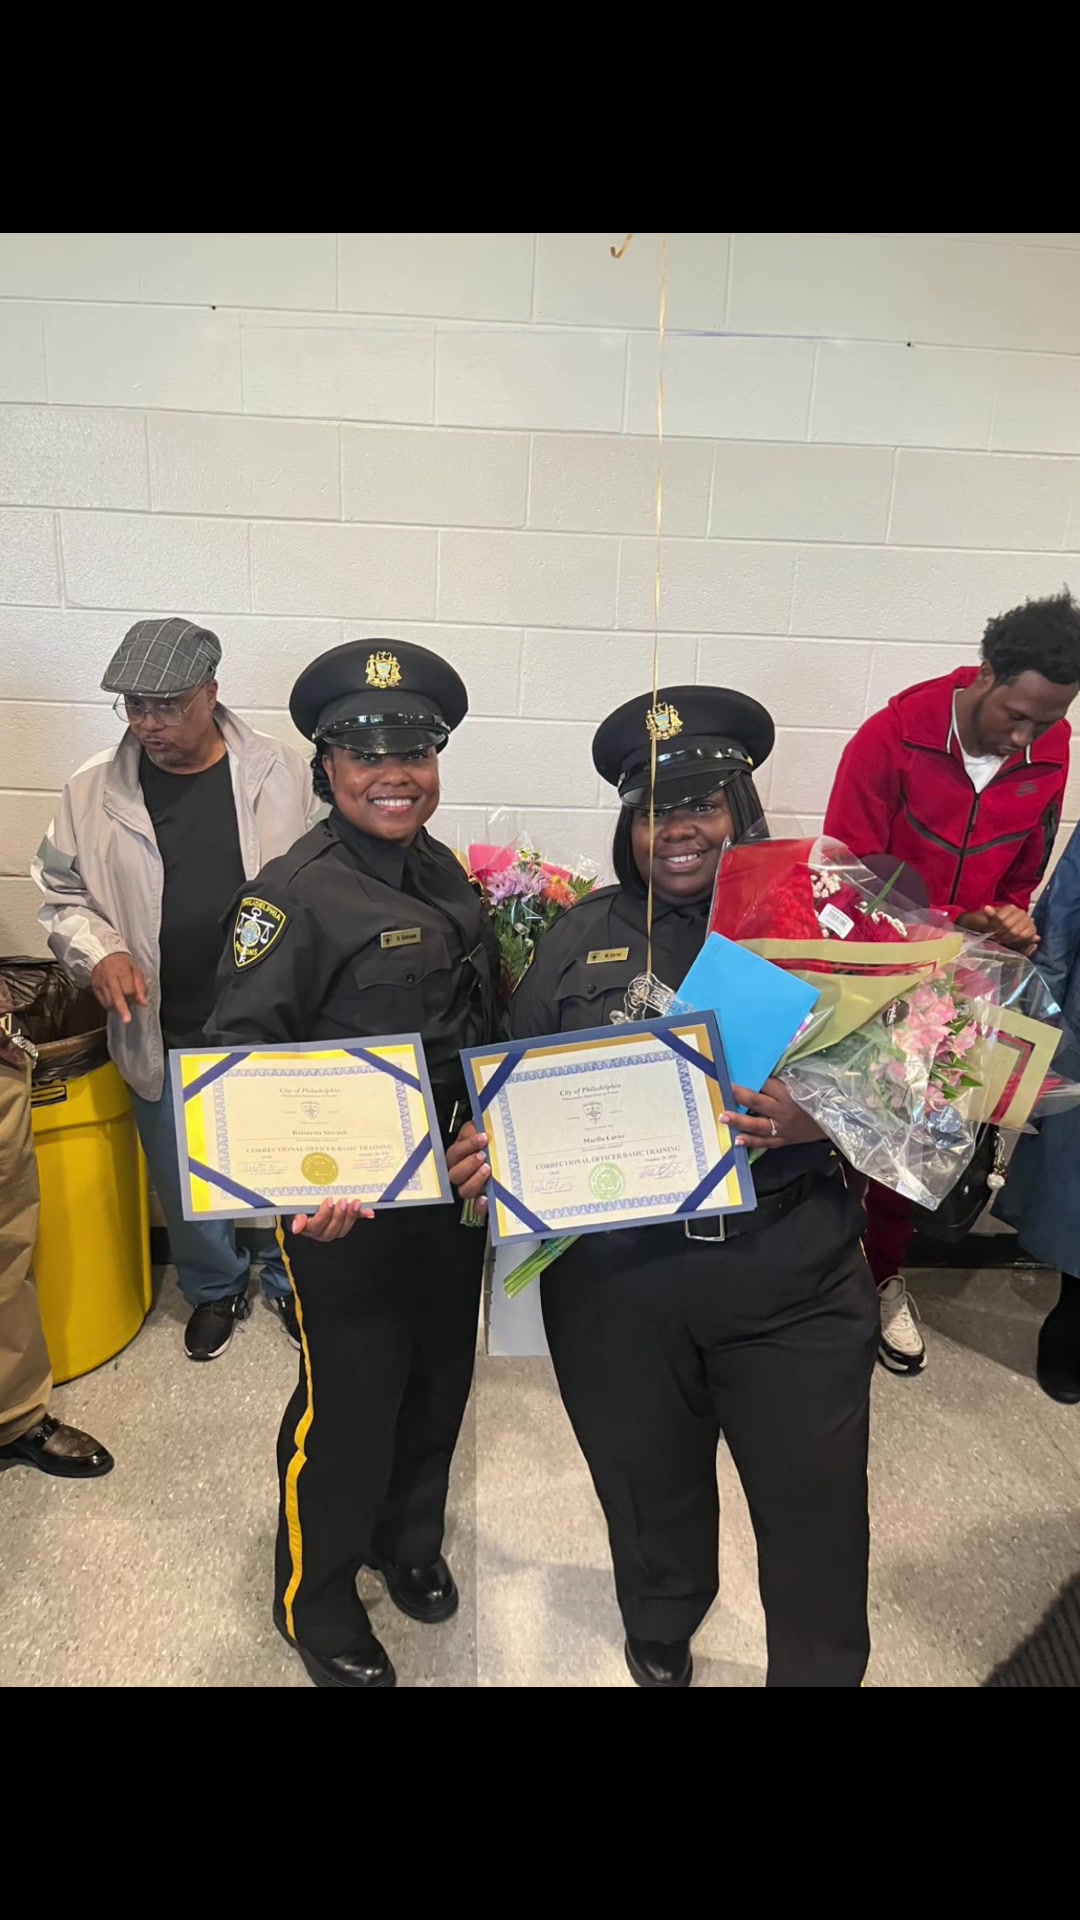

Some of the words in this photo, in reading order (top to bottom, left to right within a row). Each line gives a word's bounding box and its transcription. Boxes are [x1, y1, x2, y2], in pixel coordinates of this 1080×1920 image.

[241, 899, 281, 921] PHILADELPHIA
[582, 1083, 622, 1093] Philadelphia
[535, 1157, 590, 1170] CORRECTIONAL
[592, 1153, 623, 1163] OFFICER
[623, 1150, 644, 1158] BASIC
[645, 1145, 681, 1156] TRAINING
